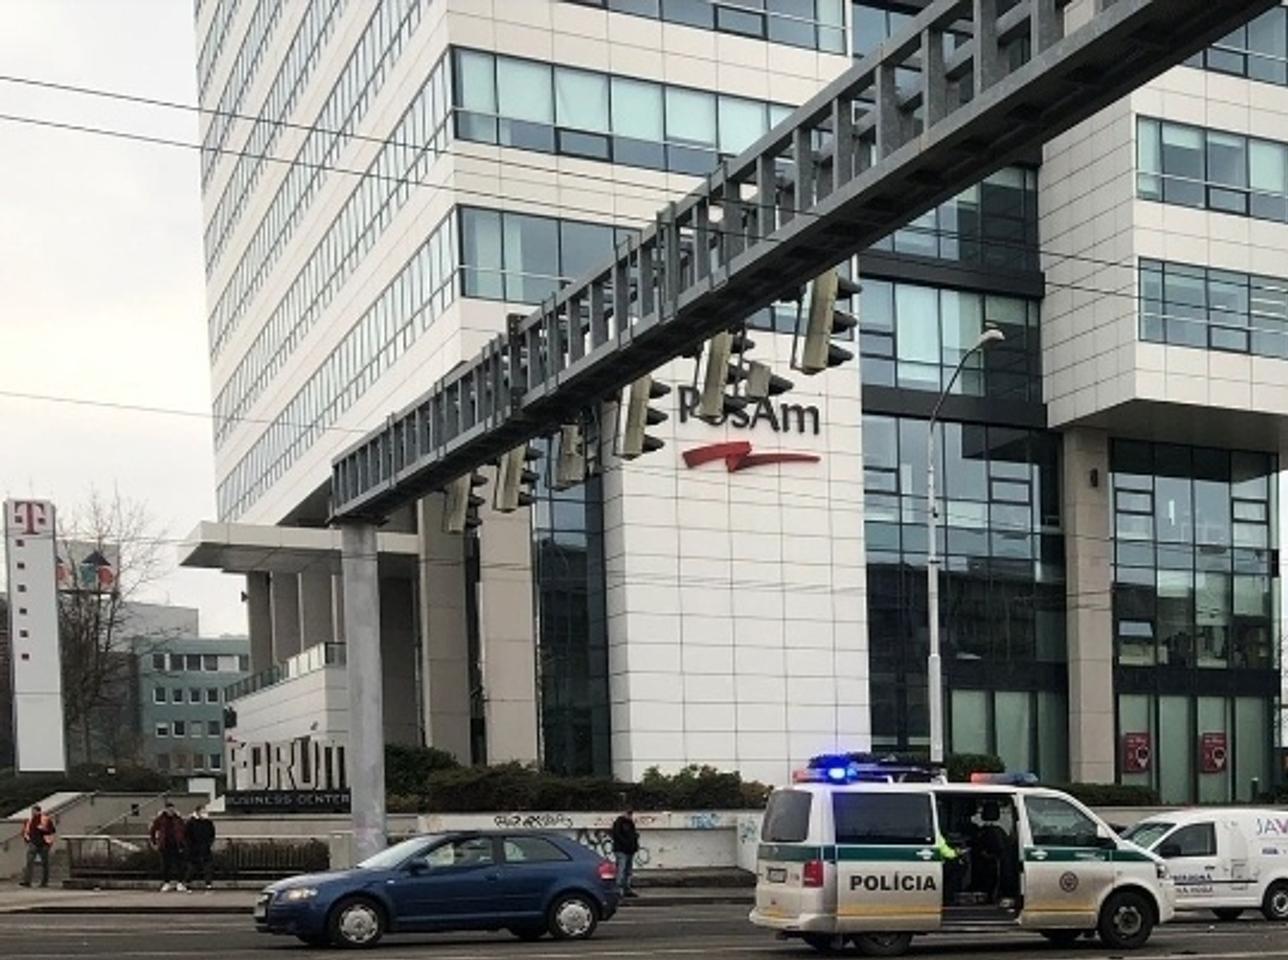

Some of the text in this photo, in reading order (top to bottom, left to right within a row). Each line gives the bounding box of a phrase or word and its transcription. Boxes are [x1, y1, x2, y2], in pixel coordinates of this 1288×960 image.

[14, 501, 46, 535] T
[297, 794, 350, 805] CENTER
[850, 871, 936, 891] POLÍCIA
